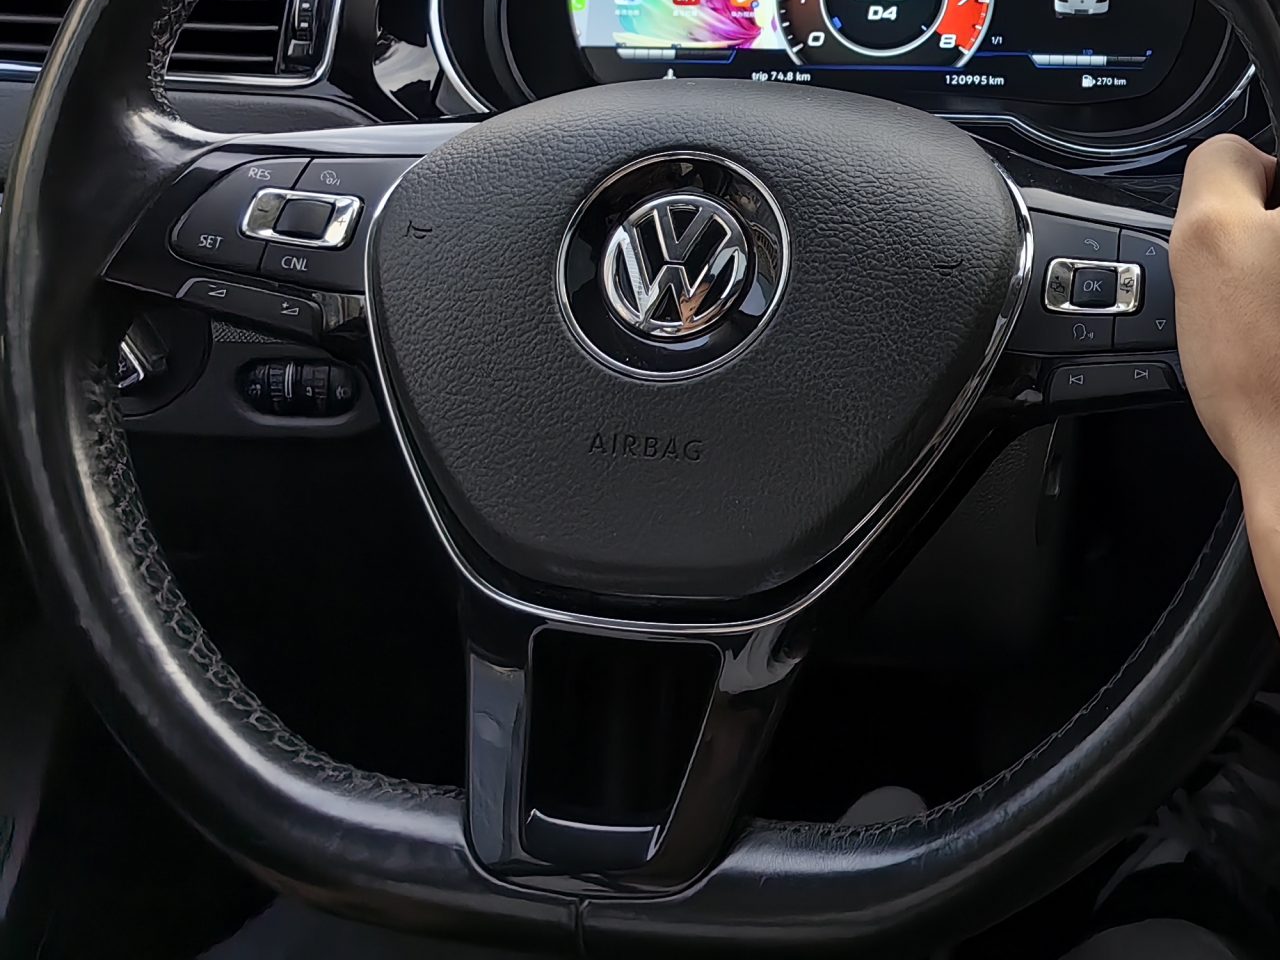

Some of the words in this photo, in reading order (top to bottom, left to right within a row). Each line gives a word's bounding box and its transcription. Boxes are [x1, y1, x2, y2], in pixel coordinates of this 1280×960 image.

[867, 6, 898, 21] D4
[807, 31, 825, 47] 0
[939, 34, 957, 49] 8
[751, 70, 768, 82] trip
[770, 70, 794, 81] 74.8
[796, 71, 811, 82] km
[945, 74, 987, 86] 120995
[988, 74, 1005, 86] km
[1096, 77, 1113, 86] 270
[1113, 77, 1127, 86] km
[248, 167, 272, 181] RES
[199, 234, 224, 249] SET
[281, 255, 309, 271] CNL
[1083, 279, 1103, 292] OK
[588, 432, 703, 462] AIRBAG
